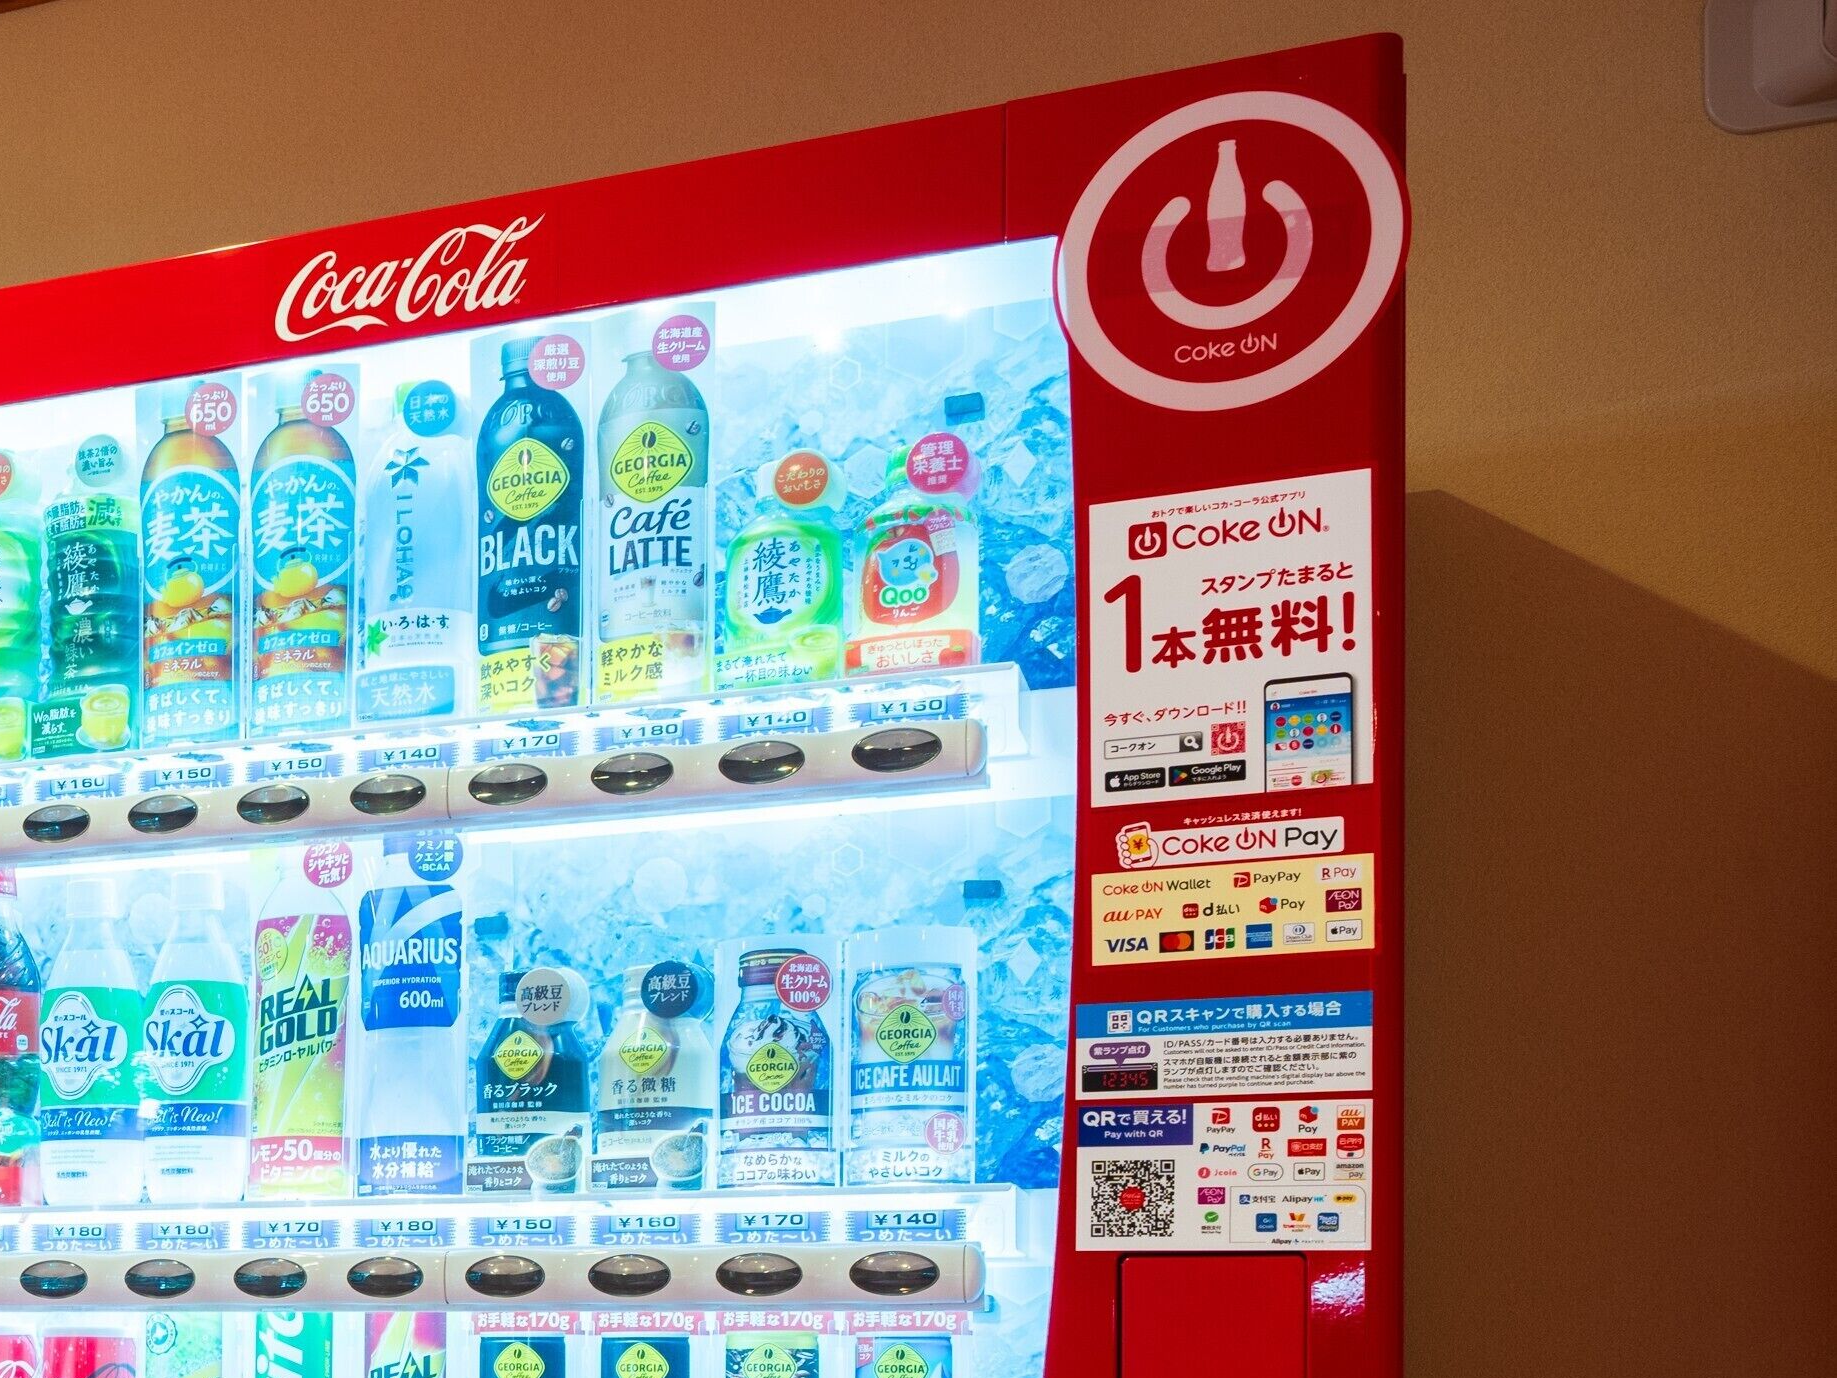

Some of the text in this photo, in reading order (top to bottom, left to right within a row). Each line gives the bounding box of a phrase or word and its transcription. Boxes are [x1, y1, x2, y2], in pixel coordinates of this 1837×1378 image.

[274, 212, 546, 342] Coca-Cola
[1174, 333, 1278, 363] Coke ON
[190, 402, 232, 423] 650
[492, 470, 562, 490] GEORGIA
[610, 498, 691, 539] Café
[146, 502, 234, 568] 麦茶
[1172, 508, 1322, 550] Coke ON
[480, 524, 580, 577] BLACK
[609, 535, 693, 575] LATTE
[1201, 562, 1354, 595] スタンプたまると
[880, 586, 927, 606] Qoo
[372, 682, 435, 706] 天然水
[501, 733, 560, 749] ¥170
[1110, 741, 1156, 754] コークオン
[161, 766, 212, 781] ¥150
[1124, 772, 1160, 784] App Store
[1192, 763, 1242, 776] Google Play
[1162, 826, 1338, 856] Coke ON Pay
[1254, 872, 1301, 884] PayPay
[1102, 884, 1138, 896] Coke
[1166, 879, 1211, 892] Wallet
[1280, 898, 1306, 910] Pay
[1103, 908, 1162, 923] au PAY
[1104, 937, 1148, 953] VISA
[1207, 934, 1234, 944] JCB
[363, 937, 458, 970] AQUARIUS
[261, 973, 338, 1022] REAL
[399, 990, 444, 1009] 600ml
[521, 984, 563, 1000] 高級豆
[1136, 1001, 1342, 1024] QRスキャンで購入する場合
[260, 1006, 338, 1056] GOLD
[1138, 1025, 1150, 1033] For
[1152, 1024, 1191, 1032] Customers
[1193, 1023, 1209, 1031] who
[1212, 1022, 1246, 1031] purchase
[1093, 1044, 1147, 1055] 紫ランプ点灯
[732, 1092, 816, 1115] ICE COCOA
[1104, 1129, 1164, 1139] Pay with QR
[1213, 1144, 1246, 1152] PayPal
[381, 1220, 435, 1232] ¥180
[743, 1214, 804, 1226] ¥170
[874, 1213, 938, 1225] ¥140
[854, 1312, 957, 1329] お手軽な170g
